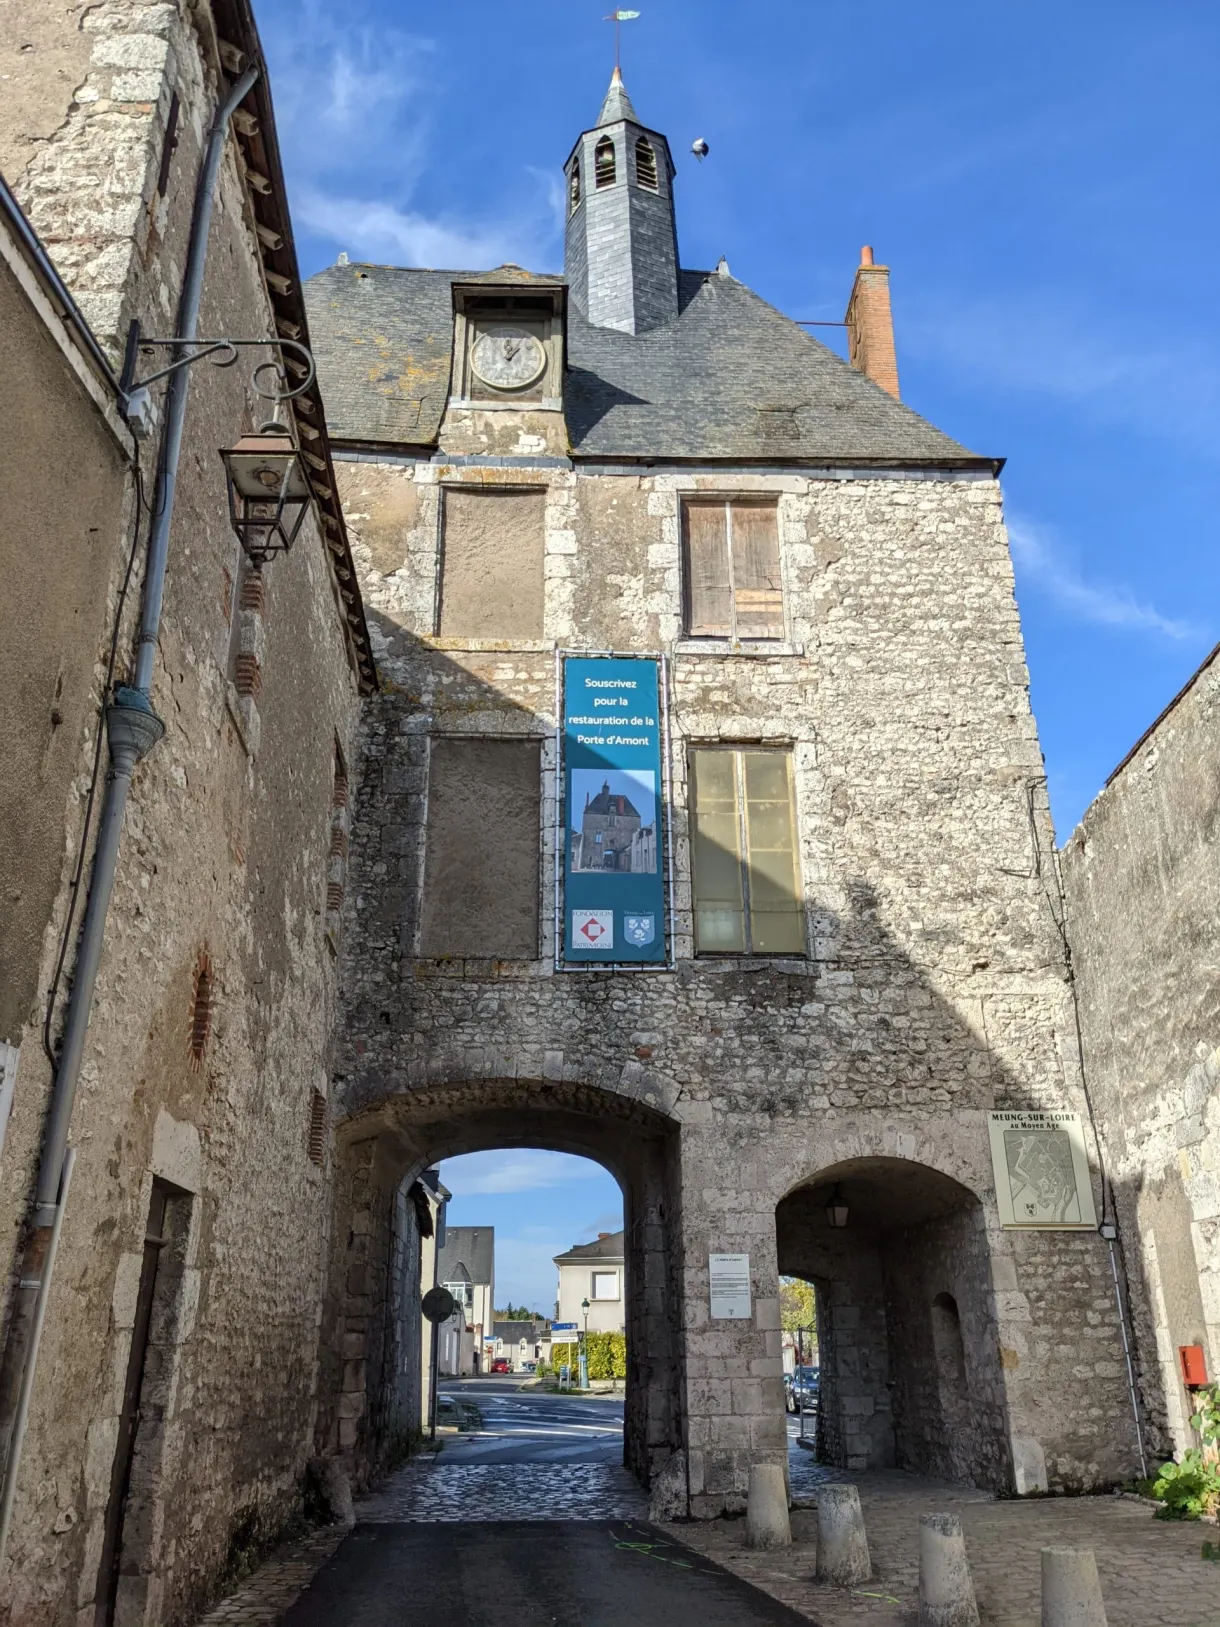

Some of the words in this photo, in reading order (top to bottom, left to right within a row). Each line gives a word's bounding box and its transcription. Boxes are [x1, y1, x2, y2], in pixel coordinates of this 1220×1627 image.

[585, 678, 637, 688] Souscrivez
[594, 697, 617, 707] pour
[619, 697, 628, 706] la
[568, 716, 628, 725] restauration
[630, 716, 643, 726] de
[645, 716, 654, 726] la
[577, 735, 604, 745] Porte
[606, 735, 649, 746] d'Amont
[992, 1113, 1077, 1121] MEUNG-SUR-LOIRE
[1021, 1122, 1044, 1131] Moyen
